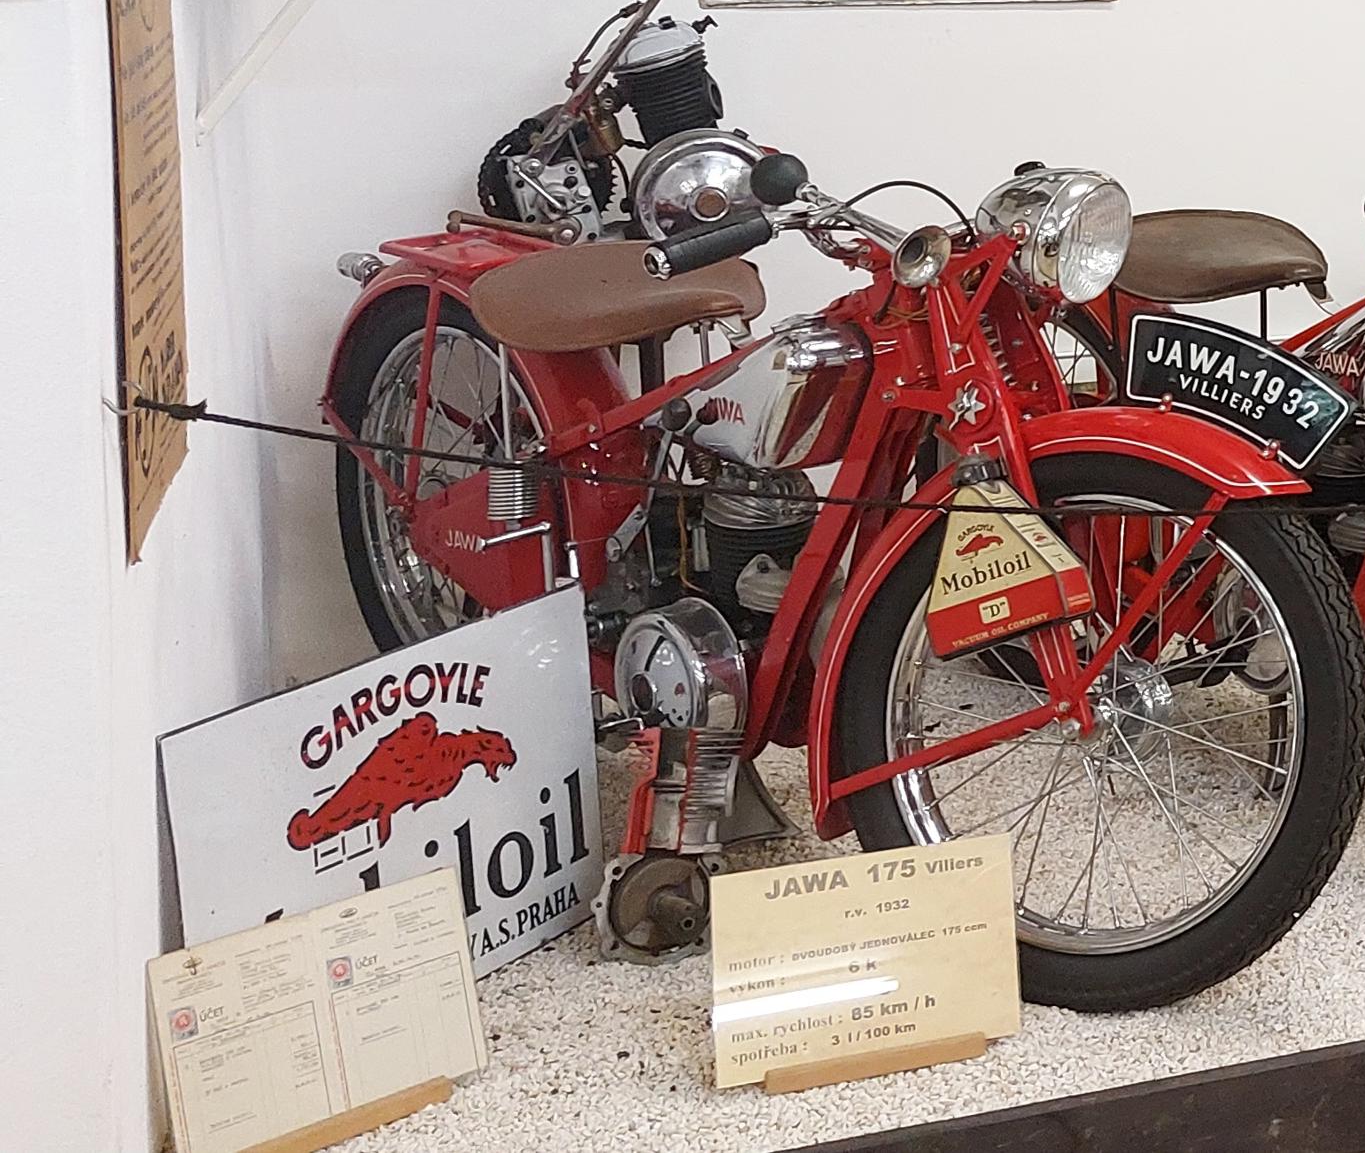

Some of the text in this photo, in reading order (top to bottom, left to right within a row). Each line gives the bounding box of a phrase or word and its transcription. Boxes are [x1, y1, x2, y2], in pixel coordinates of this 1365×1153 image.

[1147, 338, 1320, 429] JAWA-1932
[1314, 352, 1361, 377] JAWA
[1179, 373, 1266, 421] VILLIERS
[941, 551, 1032, 595] Mobiloil
[991, 625, 1007, 636] OIL
[1007, 612, 1049, 631] COMPANY
[300, 661, 491, 770] GARGOYLE
[764, 870, 849, 900] JAWA
[867, 859, 916, 883] 175
[844, 899, 910, 919] r.v. 1932
[728, 954, 776, 973] motor
[942, 925, 962, 936] 175
[964, 922, 987, 932] ccm
[848, 959, 878, 974] 6 k
[199, 1006, 224, 1022] ÚČET
[731, 1027, 768, 1044] max.
[773, 1014, 833, 1039] rychlost
[880, 1000, 908, 1016] km
[925, 994, 936, 1009] h
[731, 1022, 916, 1066] spotřeba 3 100 km
